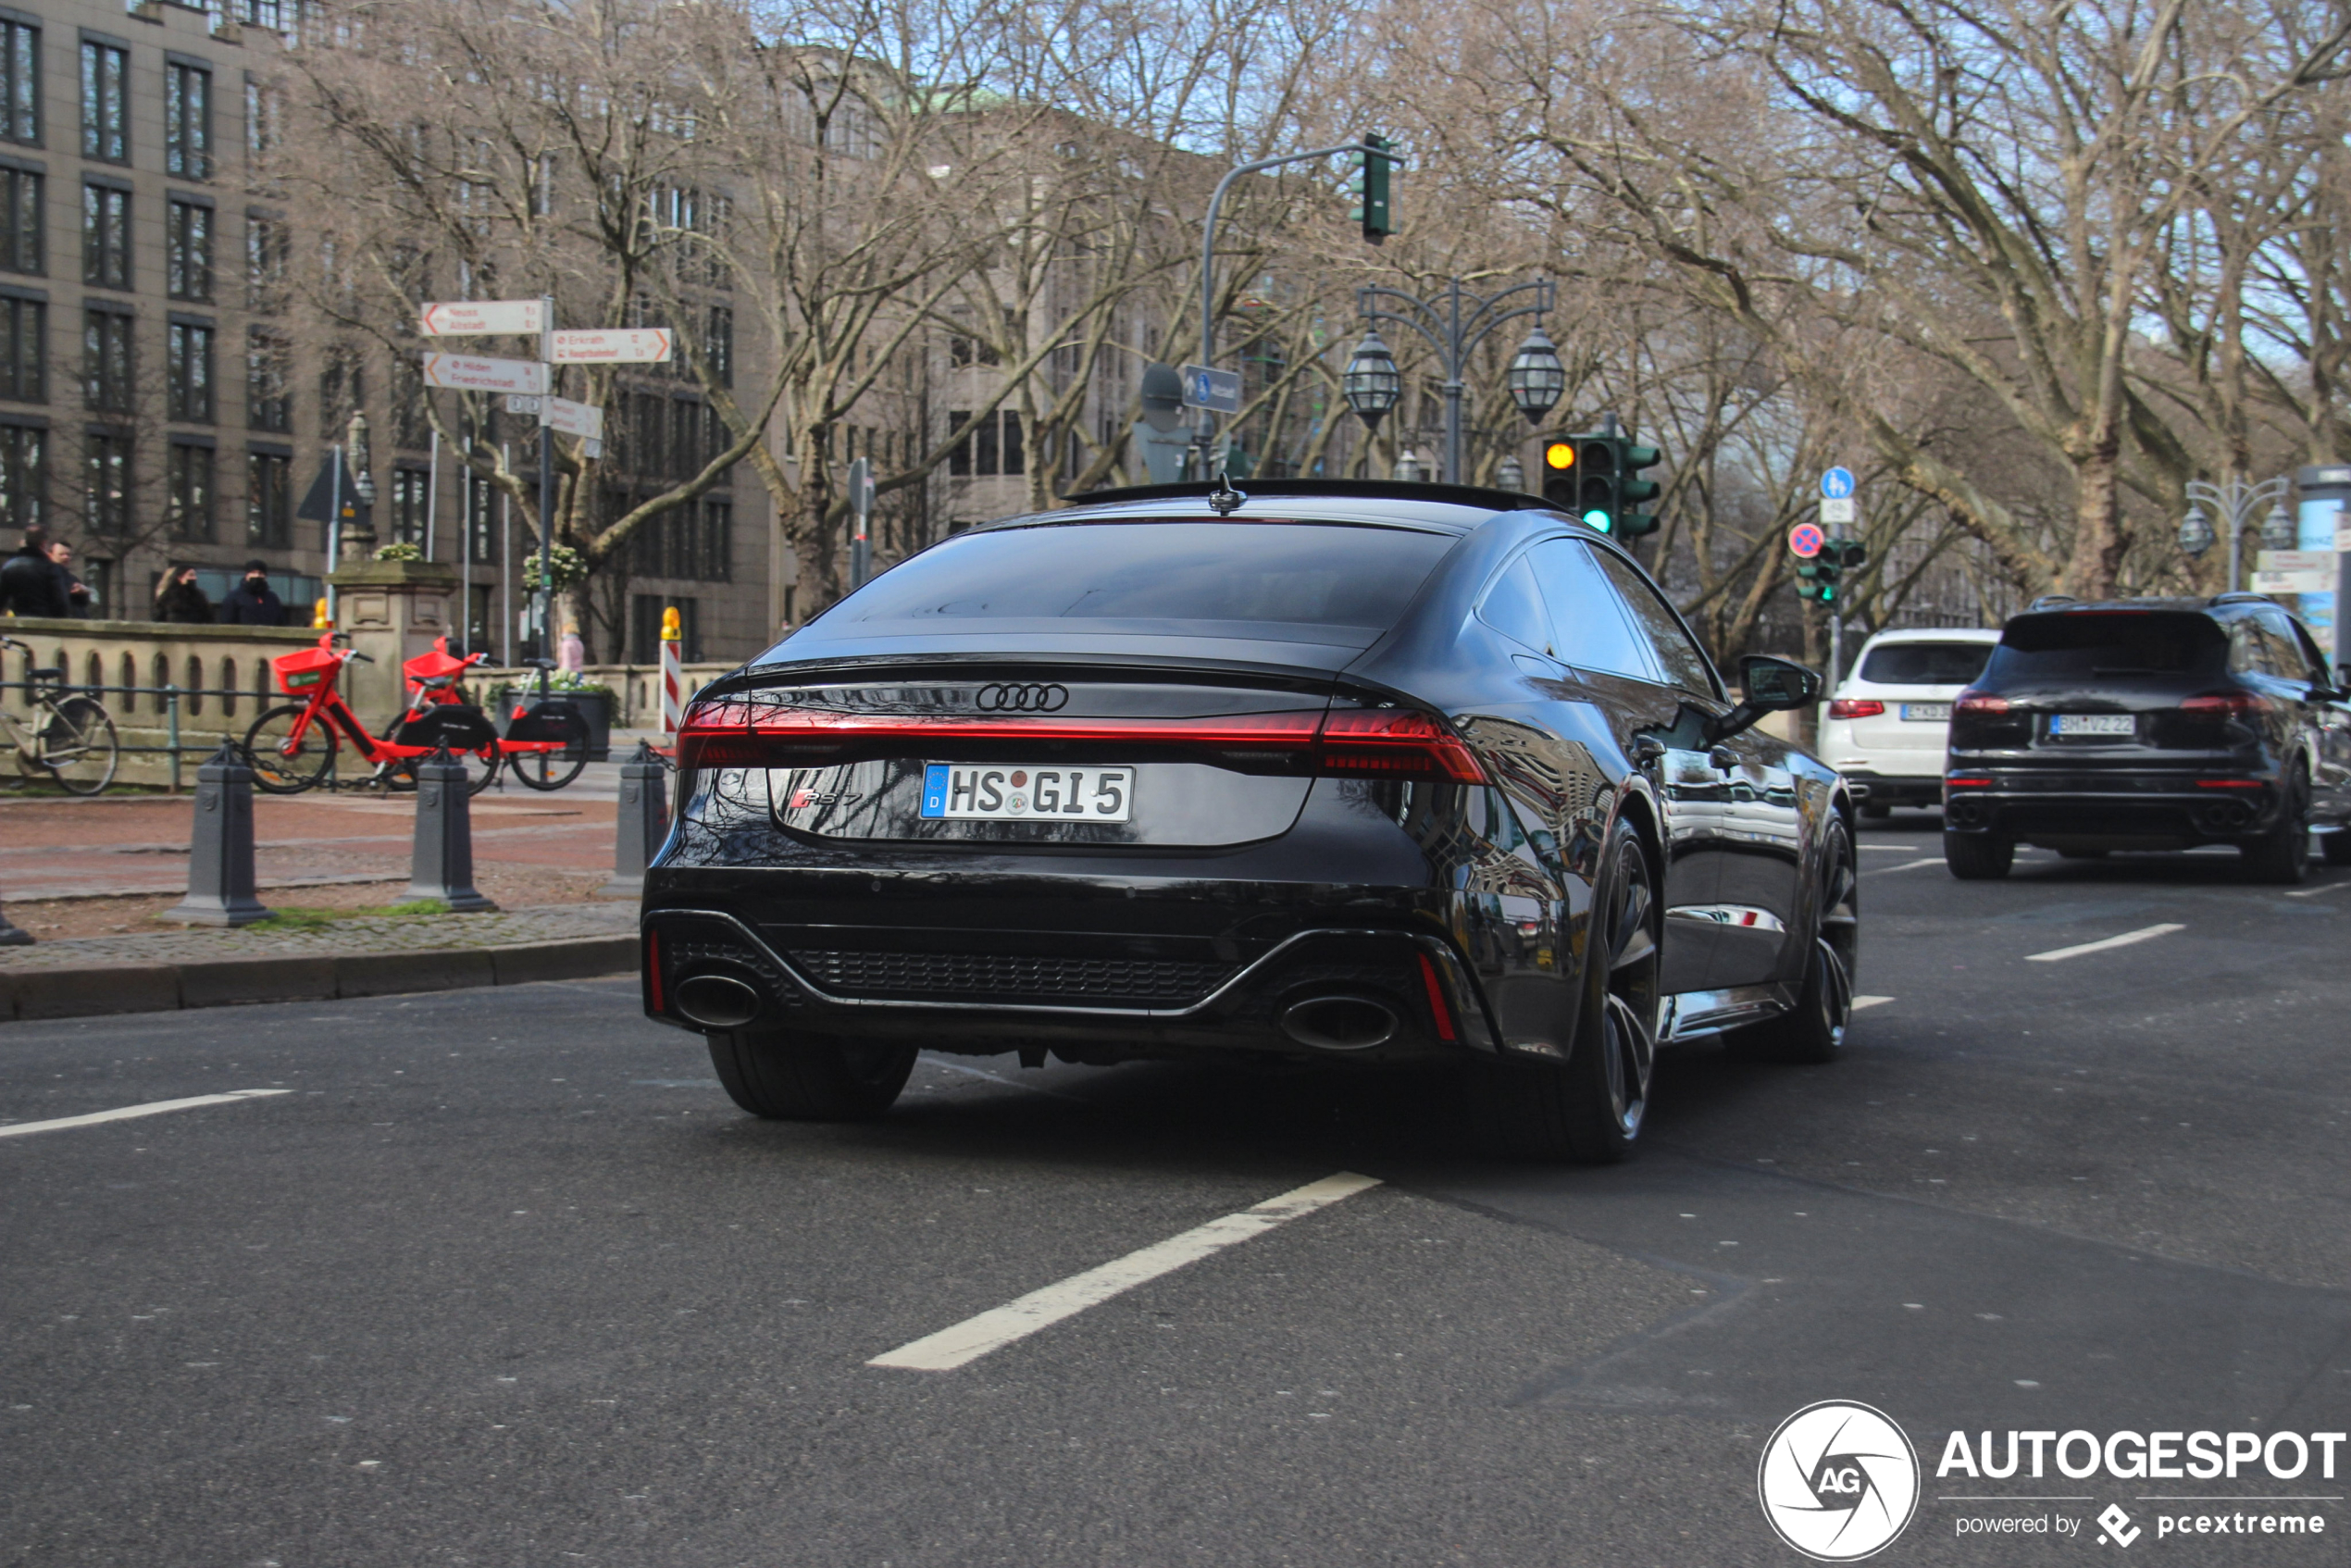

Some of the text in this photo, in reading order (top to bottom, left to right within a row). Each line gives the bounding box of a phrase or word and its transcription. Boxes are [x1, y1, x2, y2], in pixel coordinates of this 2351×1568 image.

[449, 308, 479, 317] Neuss
[450, 321, 486, 330] Altstadt
[568, 335, 605, 344] Erkrath
[568, 349, 618, 359] Hauptbahnhof
[464, 362, 491, 372] Hilden
[451, 373, 516, 388] Friedrichstadt
[2059, 716, 2132, 731] BM VZ 22
[950, 771, 1125, 815] HS GI 5
[801, 792, 863, 806] RS 7
[929, 796, 939, 808] D
